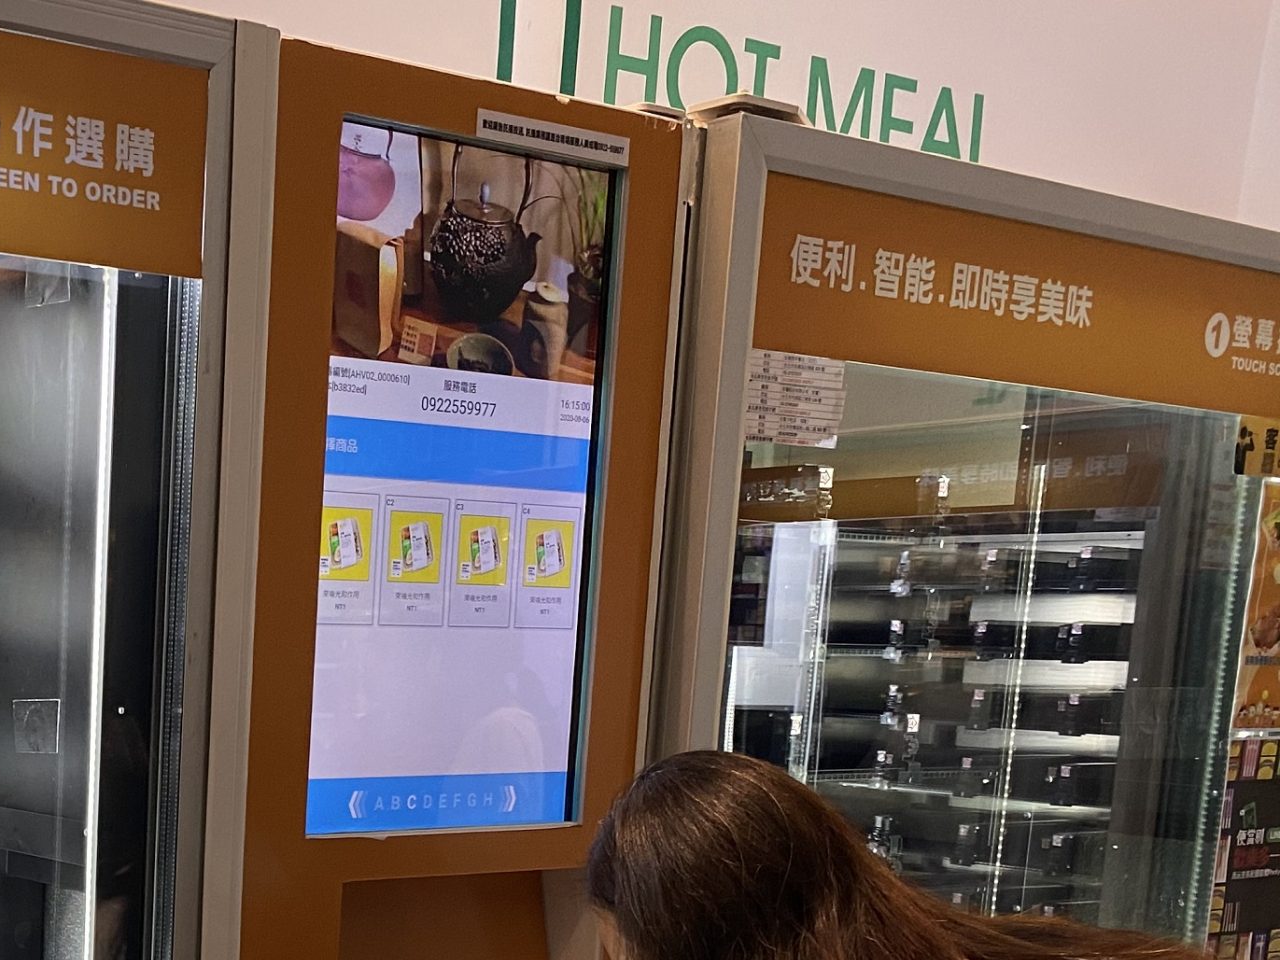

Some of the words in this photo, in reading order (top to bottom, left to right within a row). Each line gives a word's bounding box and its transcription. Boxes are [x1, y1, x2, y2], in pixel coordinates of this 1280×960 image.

[605, 5, 781, 108] HOT
[47, 176, 78, 199] TO
[85, 182, 161, 211] ORDER
[1232, 315, 1280, 354] 螢幕
[1232, 356, 1267, 375] TOUCH
[443, 379, 477, 394] 服務電話
[421, 396, 497, 417] 0922559977
[374, 796, 384, 811] A
[391, 796, 400, 811] B
[407, 795, 417, 810] C
[439, 793, 447, 809] E
[467, 793, 477, 807] G
[483, 792, 493, 806] H
